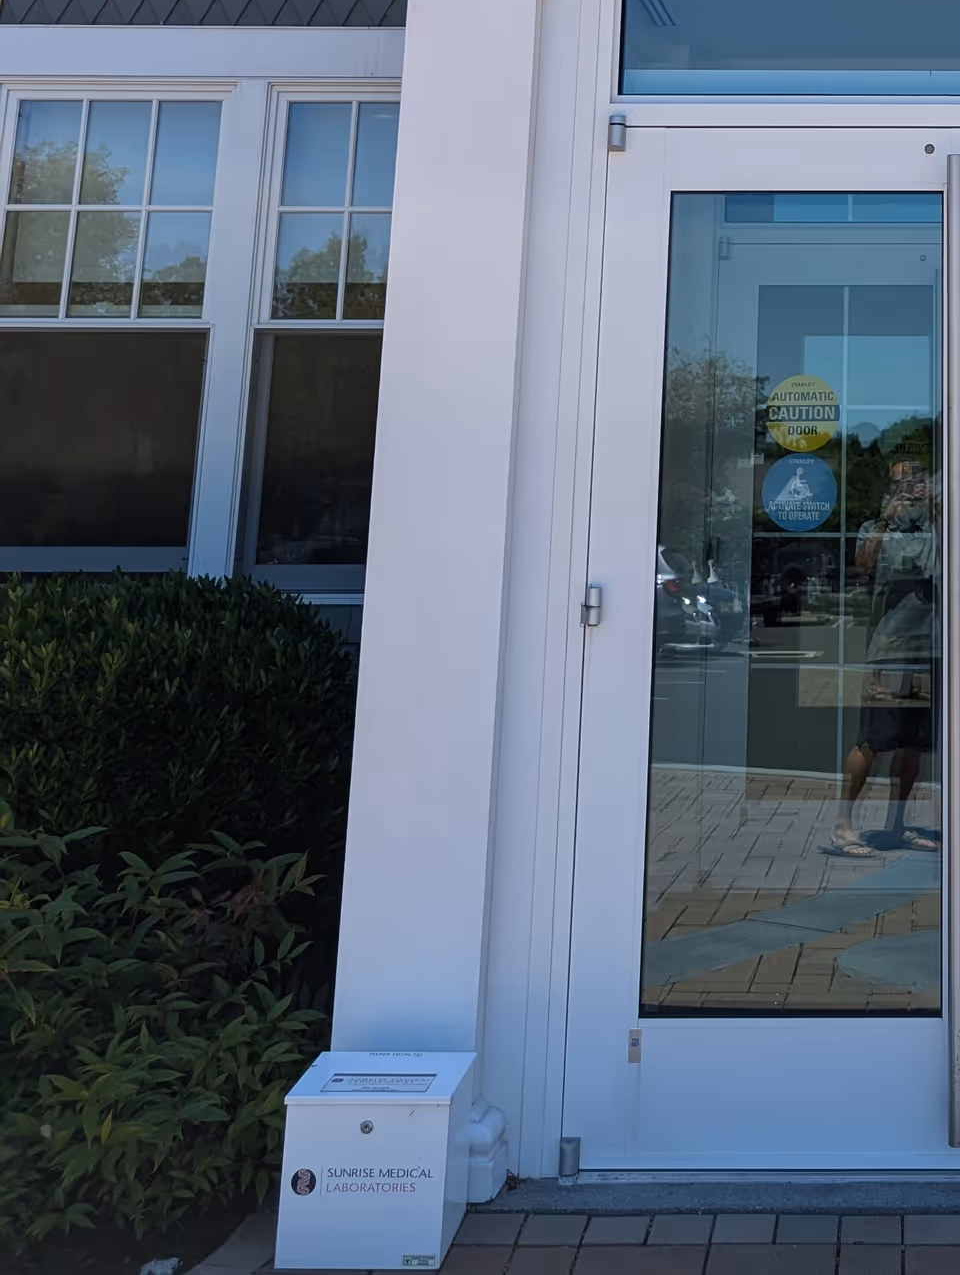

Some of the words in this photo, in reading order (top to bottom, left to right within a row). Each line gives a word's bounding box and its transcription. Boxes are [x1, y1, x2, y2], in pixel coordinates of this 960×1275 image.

[773, 391, 834, 402] AUTOMATIC
[768, 406, 835, 420] CAUTION
[787, 425, 818, 436] DOOR
[768, 501, 802, 511] ACTIVATE
[803, 501, 830, 511] SWITCH
[778, 511, 787, 520] TO
[788, 511, 819, 521] OPERATE
[327, 1167, 375, 1178] SUNRISE
[378, 1168, 434, 1179] MEDICAL
[326, 1182, 416, 1193] LABORATORIES
